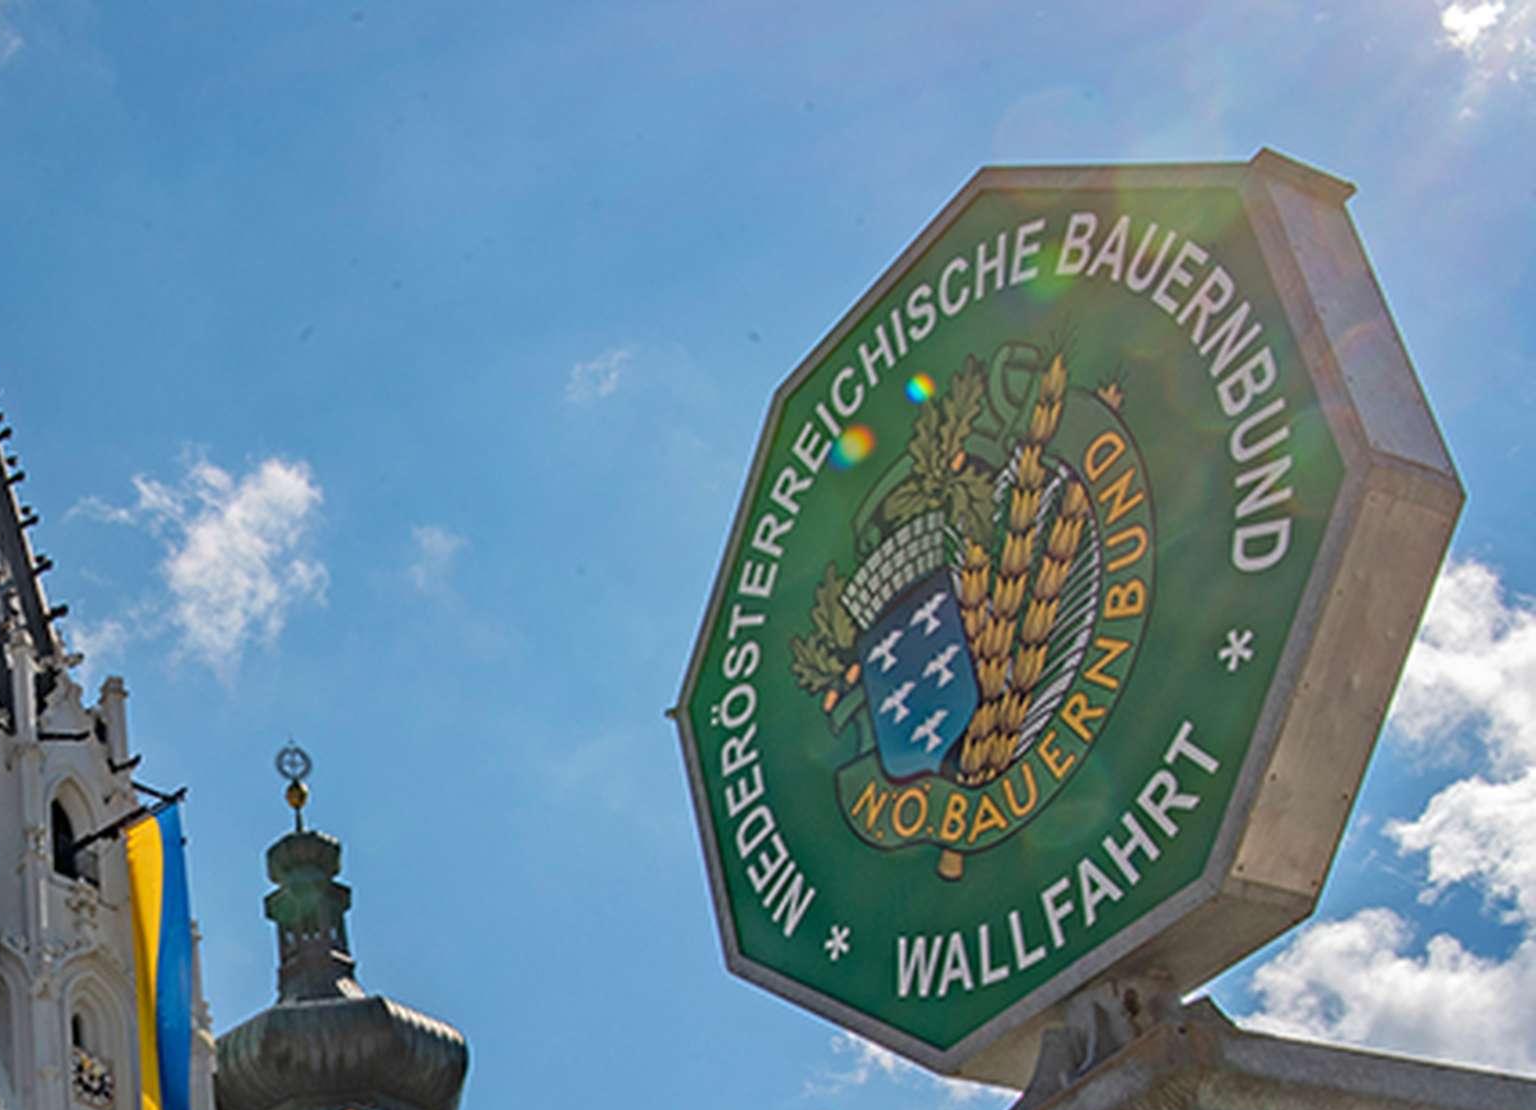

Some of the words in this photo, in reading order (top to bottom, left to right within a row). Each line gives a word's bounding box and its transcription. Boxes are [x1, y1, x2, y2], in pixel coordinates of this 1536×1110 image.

[711, 217, 1048, 938] NIEDERÖSTERREICHISCHE
[1054, 211, 1293, 573] BAUERNBUND
[896, 721, 1221, 998] WALLFAHRT
